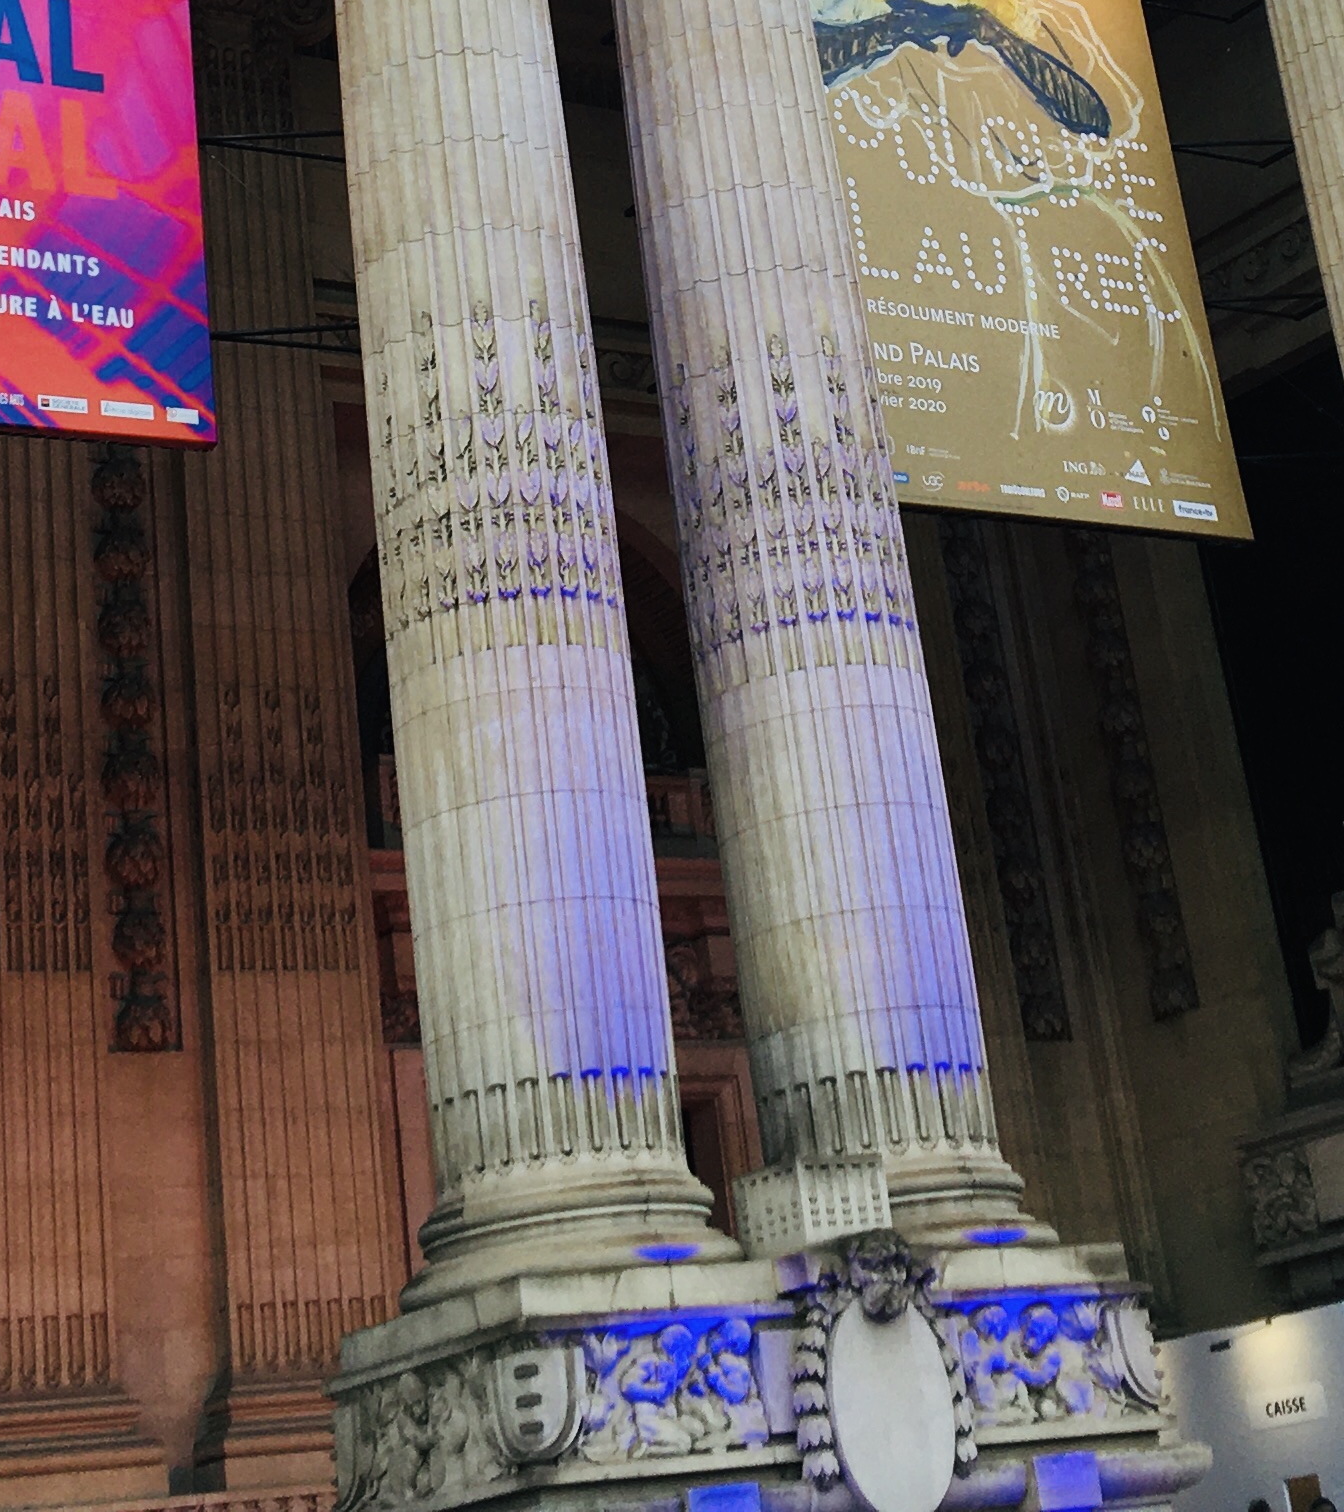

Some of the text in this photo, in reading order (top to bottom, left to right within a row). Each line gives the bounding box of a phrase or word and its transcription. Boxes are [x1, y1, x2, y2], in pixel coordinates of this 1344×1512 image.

[47, 295, 63, 321] À
[866, 297, 1061, 340] RÉSOLUMENT MODERNE
[907, 375, 942, 394] 2019
[909, 397, 947, 414] 2020
[1063, 460, 1088, 474] ING
[1266, 1395, 1306, 1418] CAISSE
